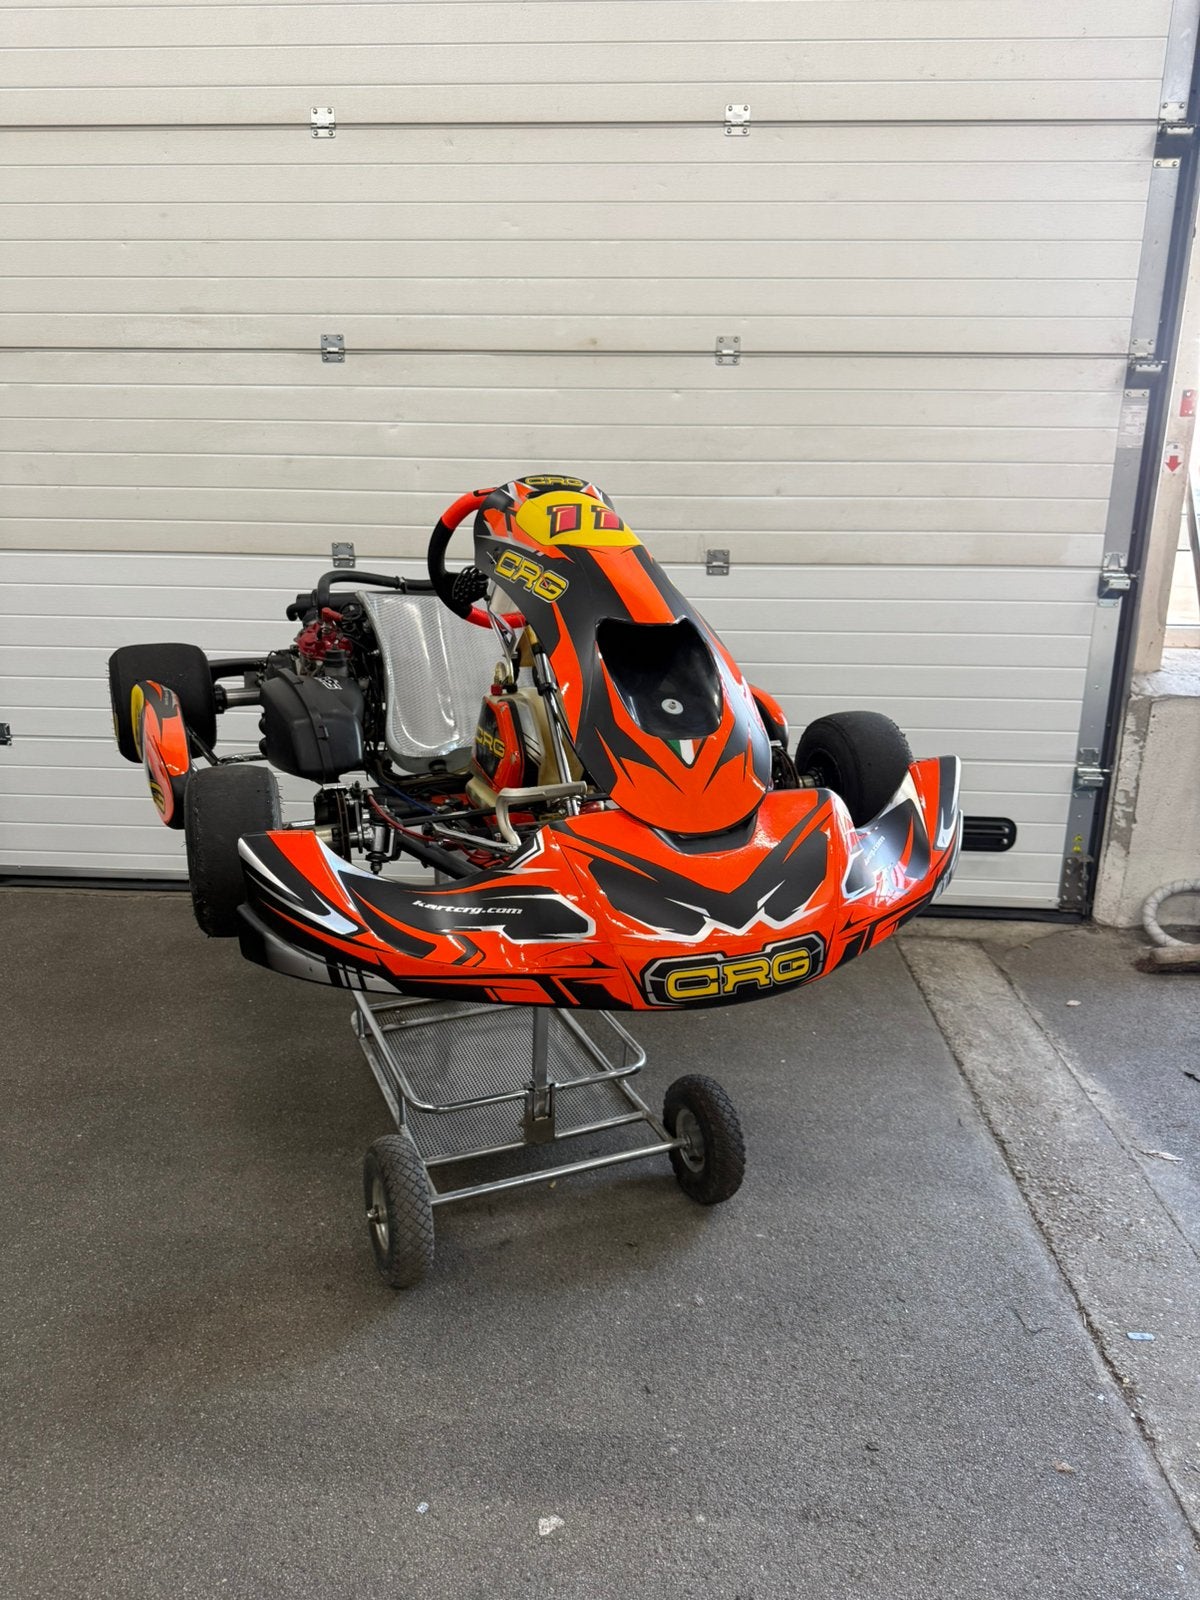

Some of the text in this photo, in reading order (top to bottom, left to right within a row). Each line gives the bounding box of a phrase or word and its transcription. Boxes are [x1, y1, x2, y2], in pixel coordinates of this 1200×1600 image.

[525, 476, 585, 487] CRG
[547, 503, 625, 538] 11
[495, 549, 569, 603] CRG
[474, 726, 506, 758] CRG
[412, 900, 523, 914] kartcrg.com
[665, 948, 812, 1001] CRG
